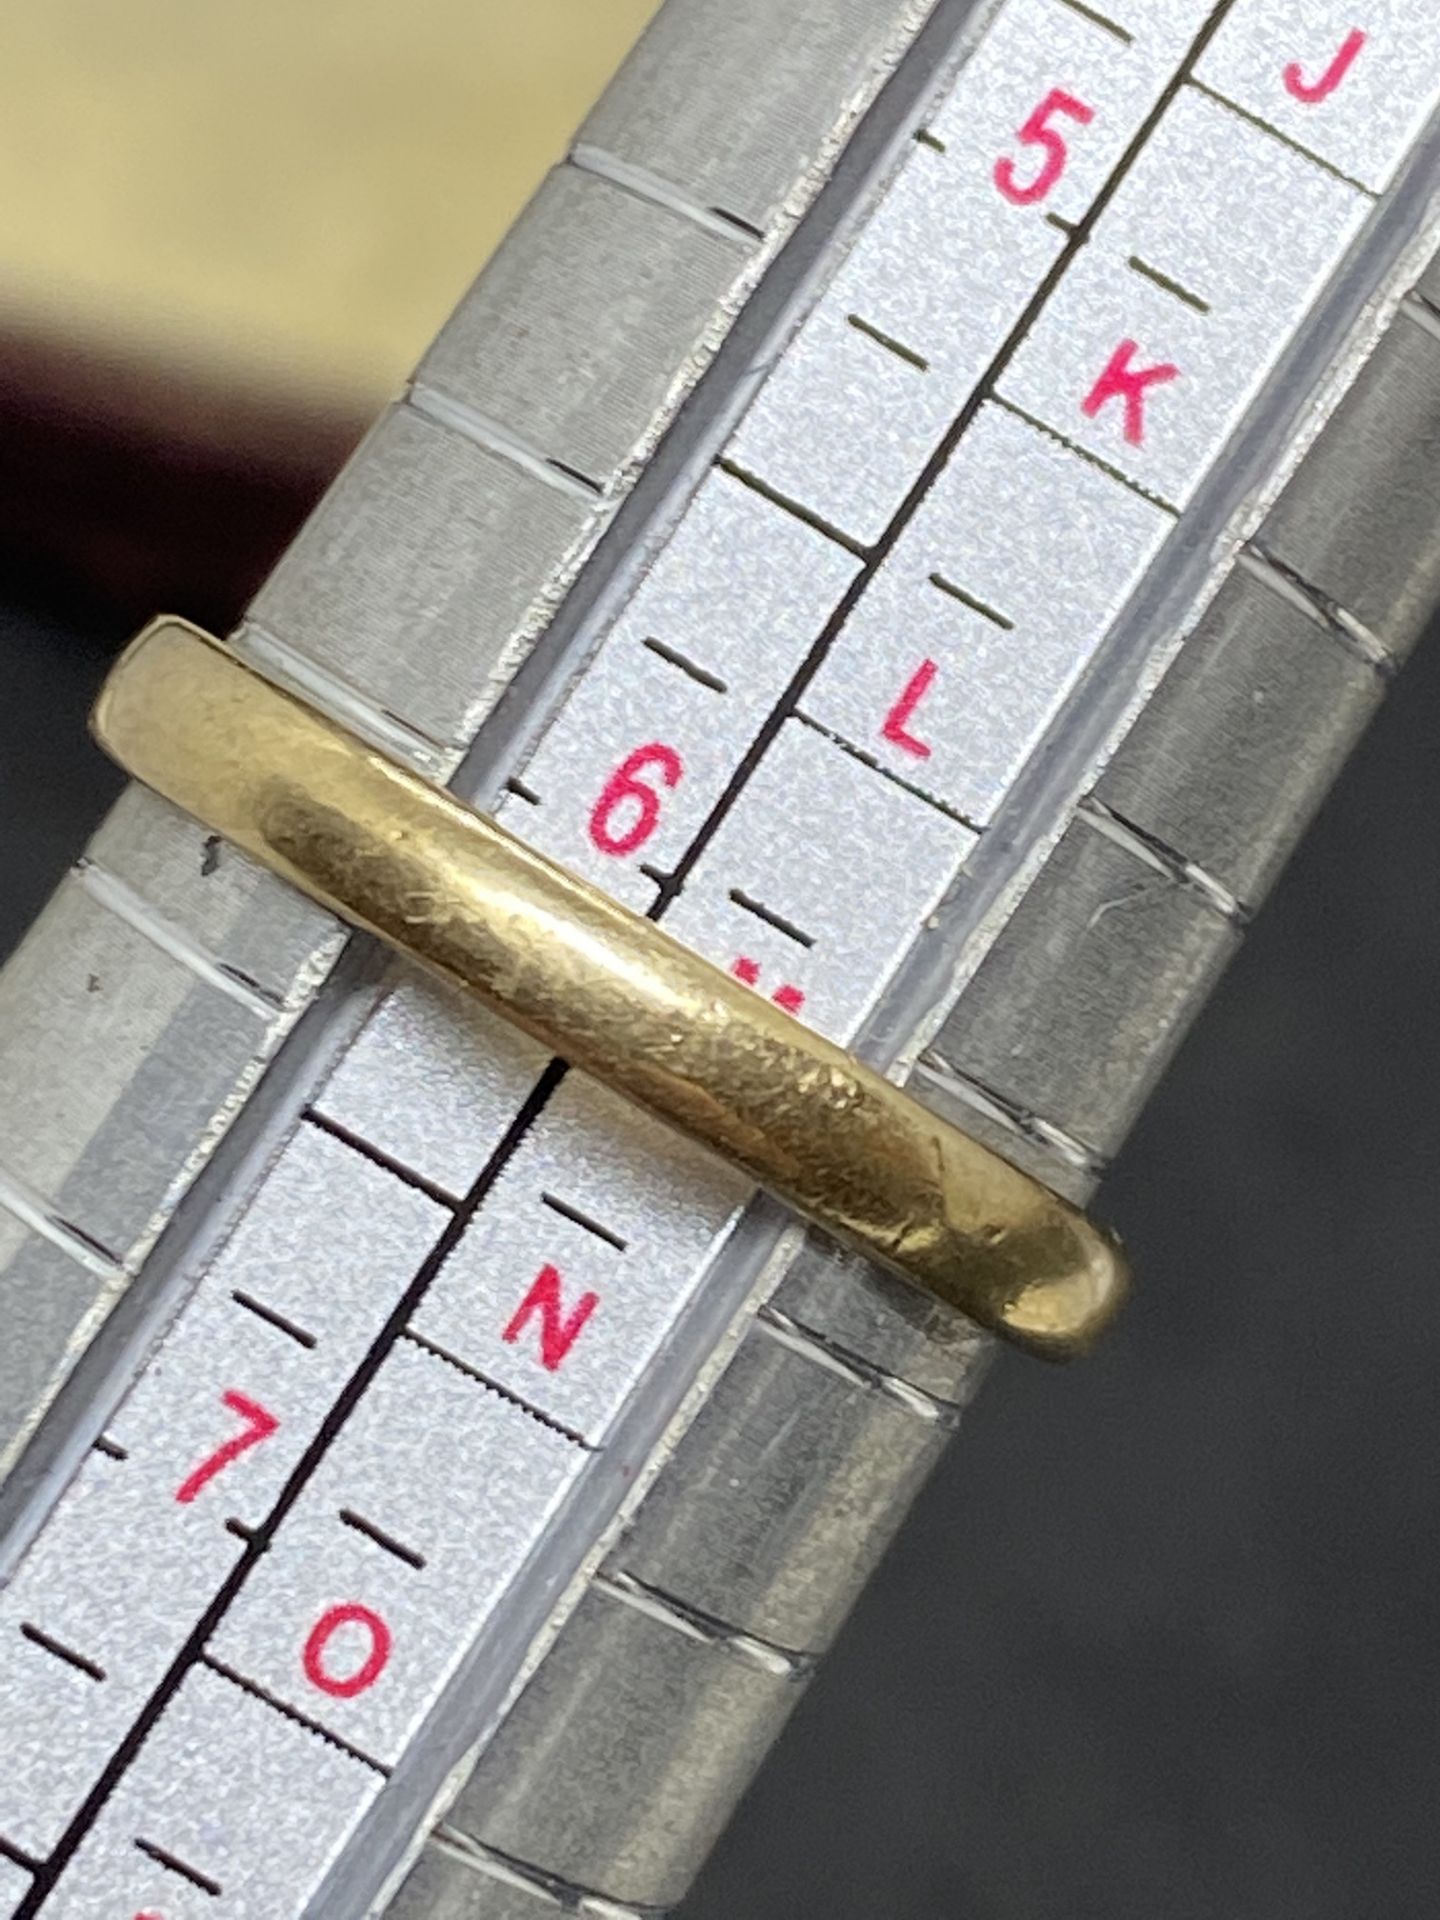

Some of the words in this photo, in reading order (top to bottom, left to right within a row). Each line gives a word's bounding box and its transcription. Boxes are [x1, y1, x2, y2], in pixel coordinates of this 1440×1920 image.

[1284, 28, 1366, 104] J
[994, 90, 1093, 205] 5
[1082, 338, 1178, 446] K
[883, 660, 936, 760] L
[589, 741, 683, 857] 6
[503, 1265, 598, 1371] N
[176, 1391, 279, 1504] 7
[303, 1603, 392, 1699] O
